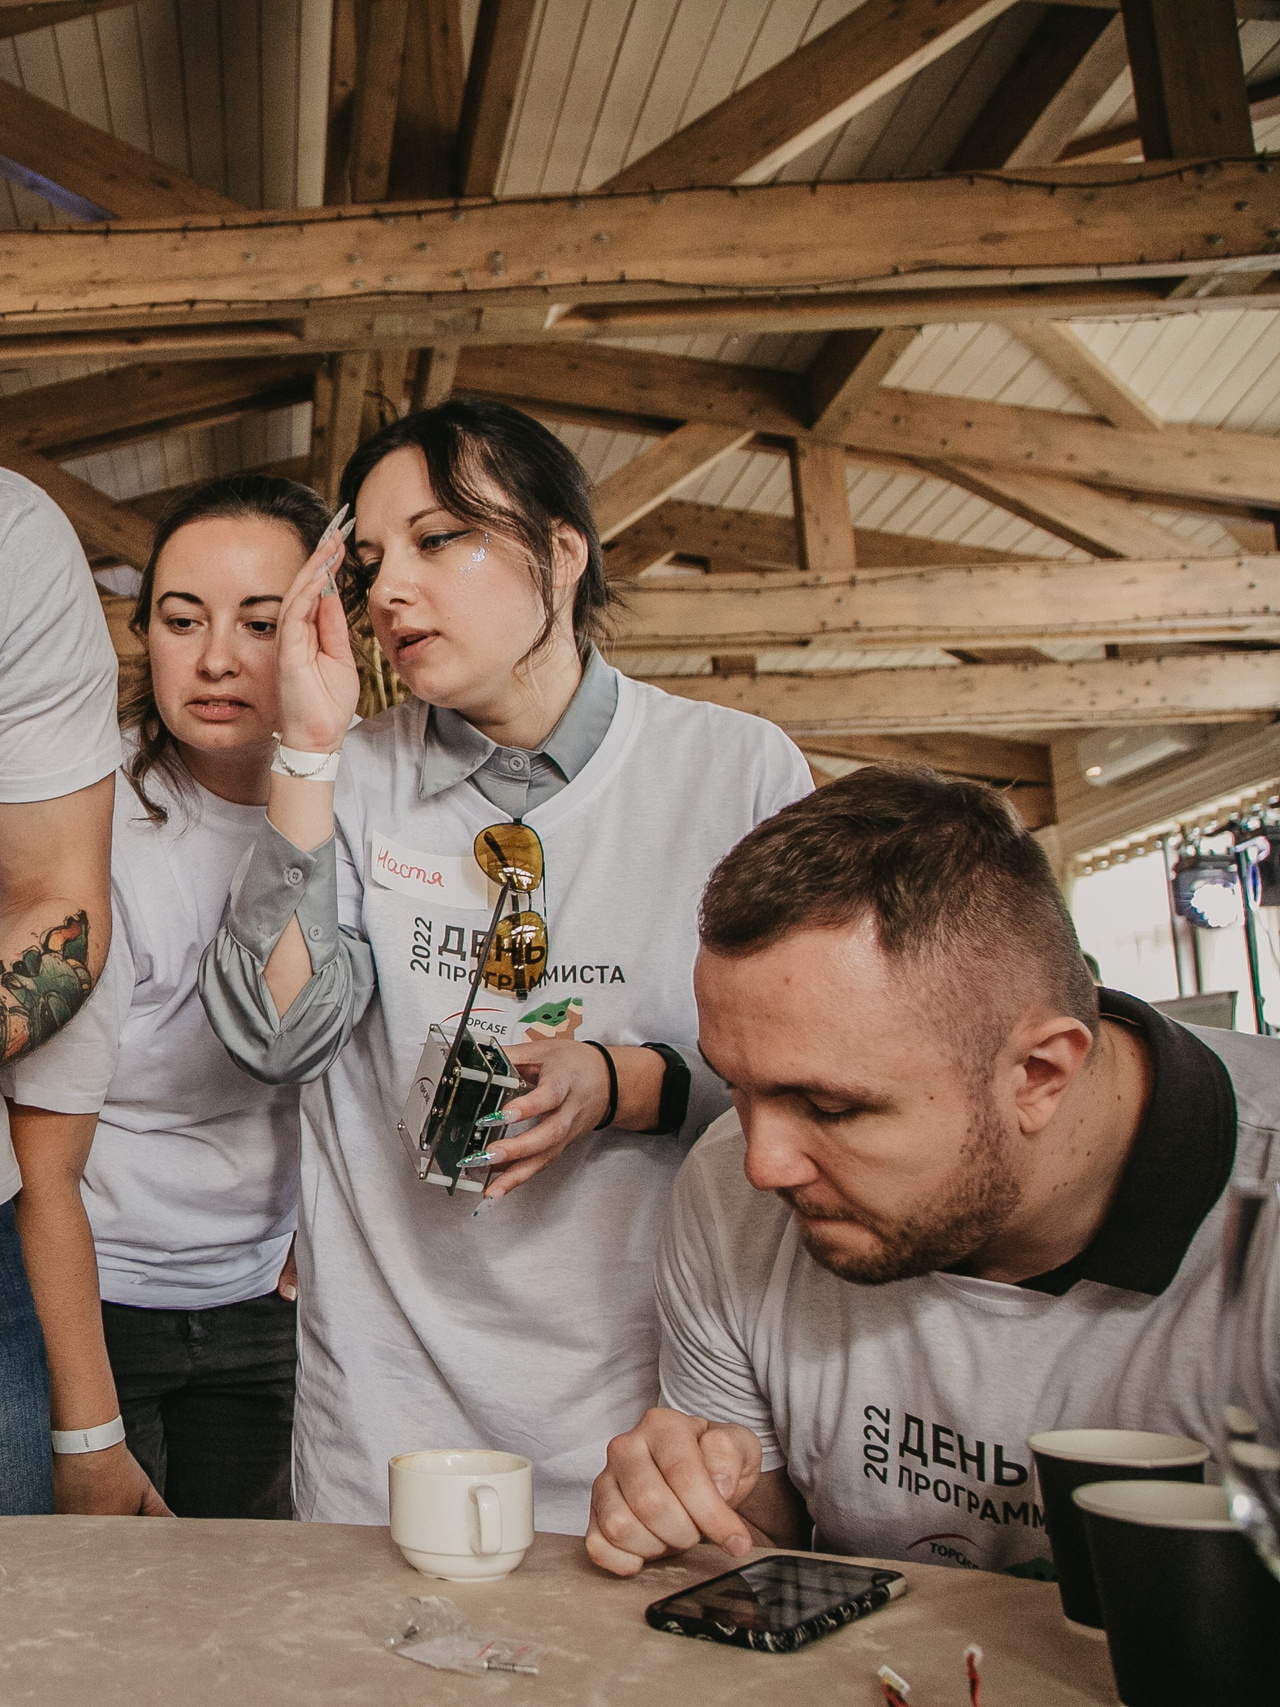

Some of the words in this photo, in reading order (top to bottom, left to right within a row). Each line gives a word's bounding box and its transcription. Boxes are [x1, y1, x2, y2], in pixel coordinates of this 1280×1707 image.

[376, 845, 445, 888] Настя
[409, 916, 432, 974] 2022
[466, 1017, 508, 1035] OPCASE
[863, 1404, 891, 1485] 2022
[898, 1412, 1028, 1487] ДЕНЬ
